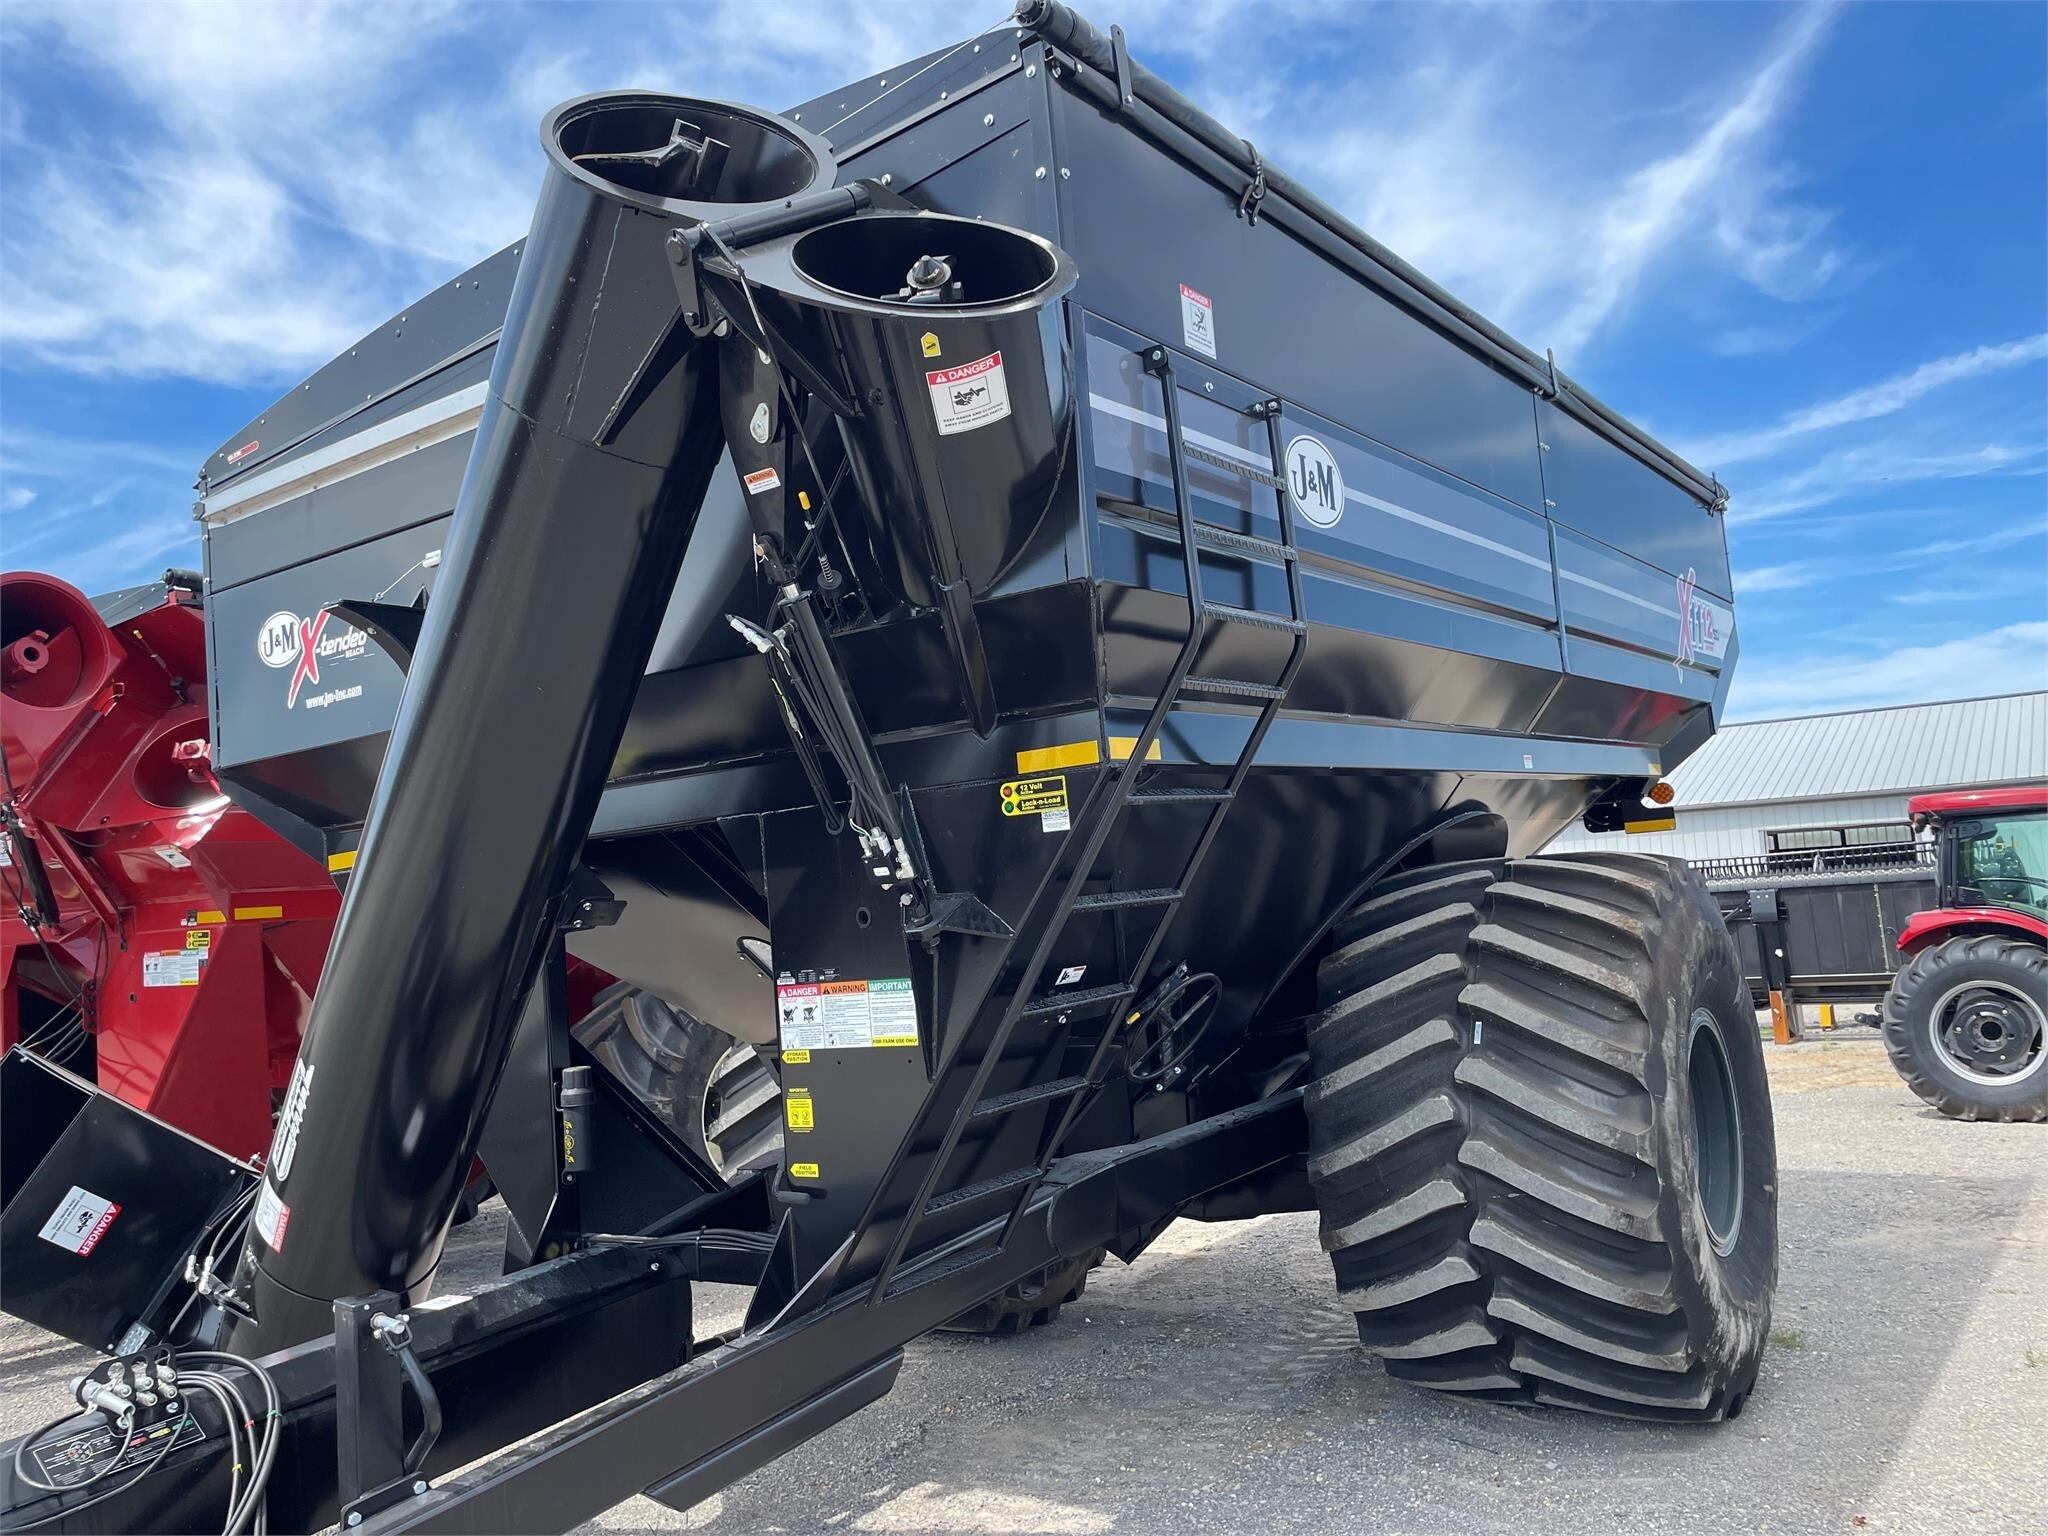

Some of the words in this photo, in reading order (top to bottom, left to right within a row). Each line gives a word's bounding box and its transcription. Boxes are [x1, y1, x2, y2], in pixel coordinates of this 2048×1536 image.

[948, 358, 995, 381] DANGER
[1291, 453, 1337, 512] J&M
[263, 622, 297, 658] J&M
[305, 685, 363, 709] www.jm-inc.com
[1019, 784, 1029, 792] 12
[1029, 782, 1043, 790] Volt
[1021, 796, 1061, 808] Lock-n-Load
[787, 986, 818, 997] DANGER
[830, 983, 866, 993] WARNING
[869, 981, 912, 992] IMPORTANT
[80, 1215, 113, 1255] DANGER
[272, 1213, 287, 1250] DANGER
